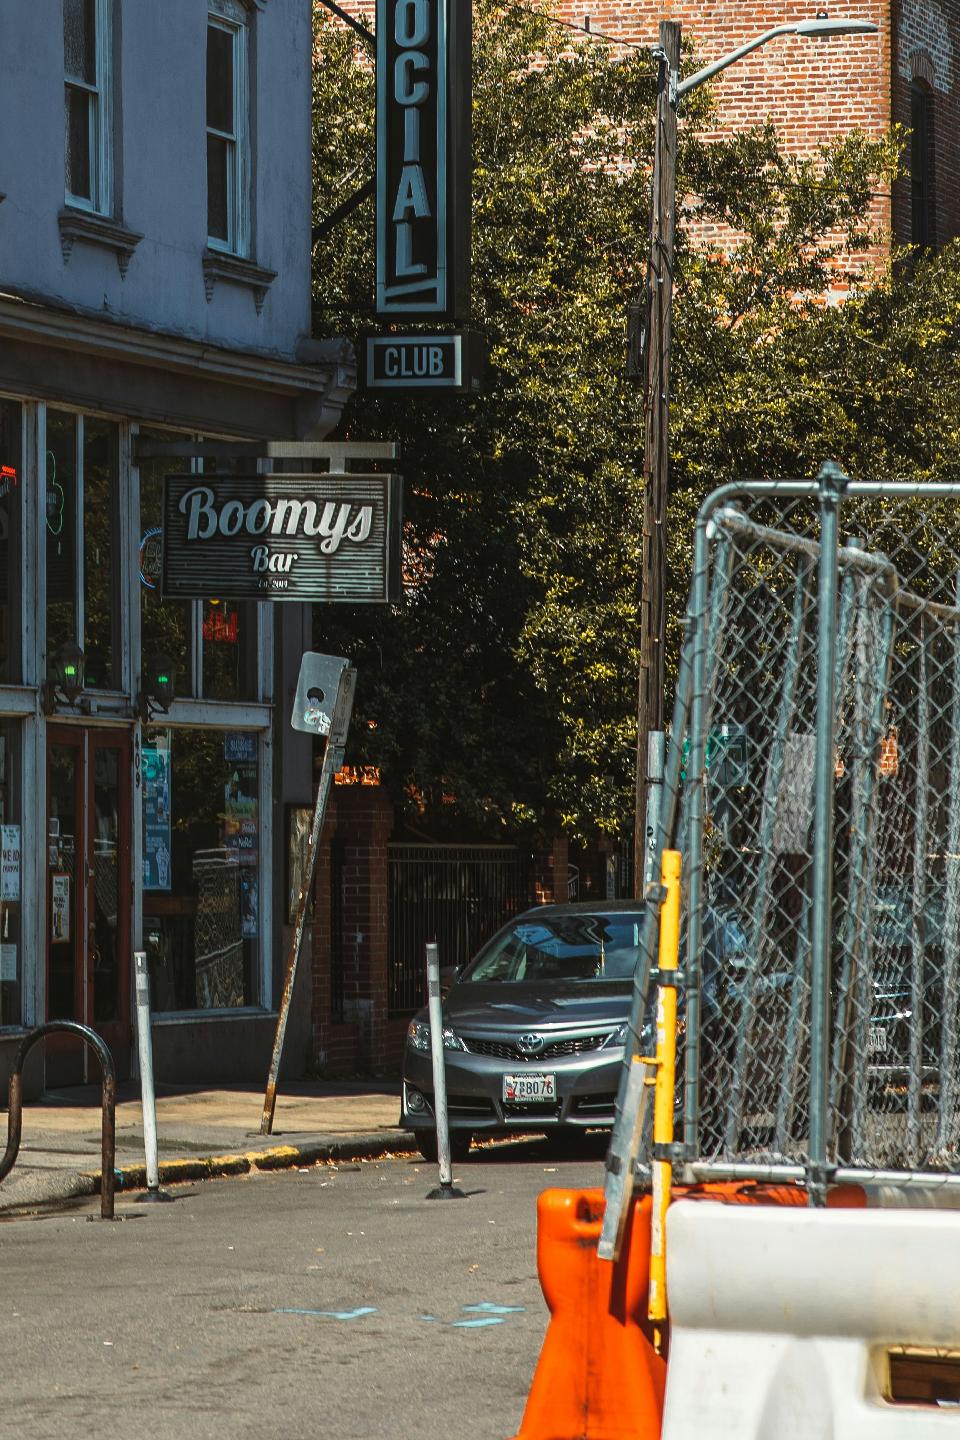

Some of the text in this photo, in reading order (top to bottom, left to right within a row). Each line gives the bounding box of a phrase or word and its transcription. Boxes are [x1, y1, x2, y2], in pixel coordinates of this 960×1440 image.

[385, 346, 444, 377] CLUB
[179, 486, 373, 554] Boomys
[251, 544, 299, 573] Bar
